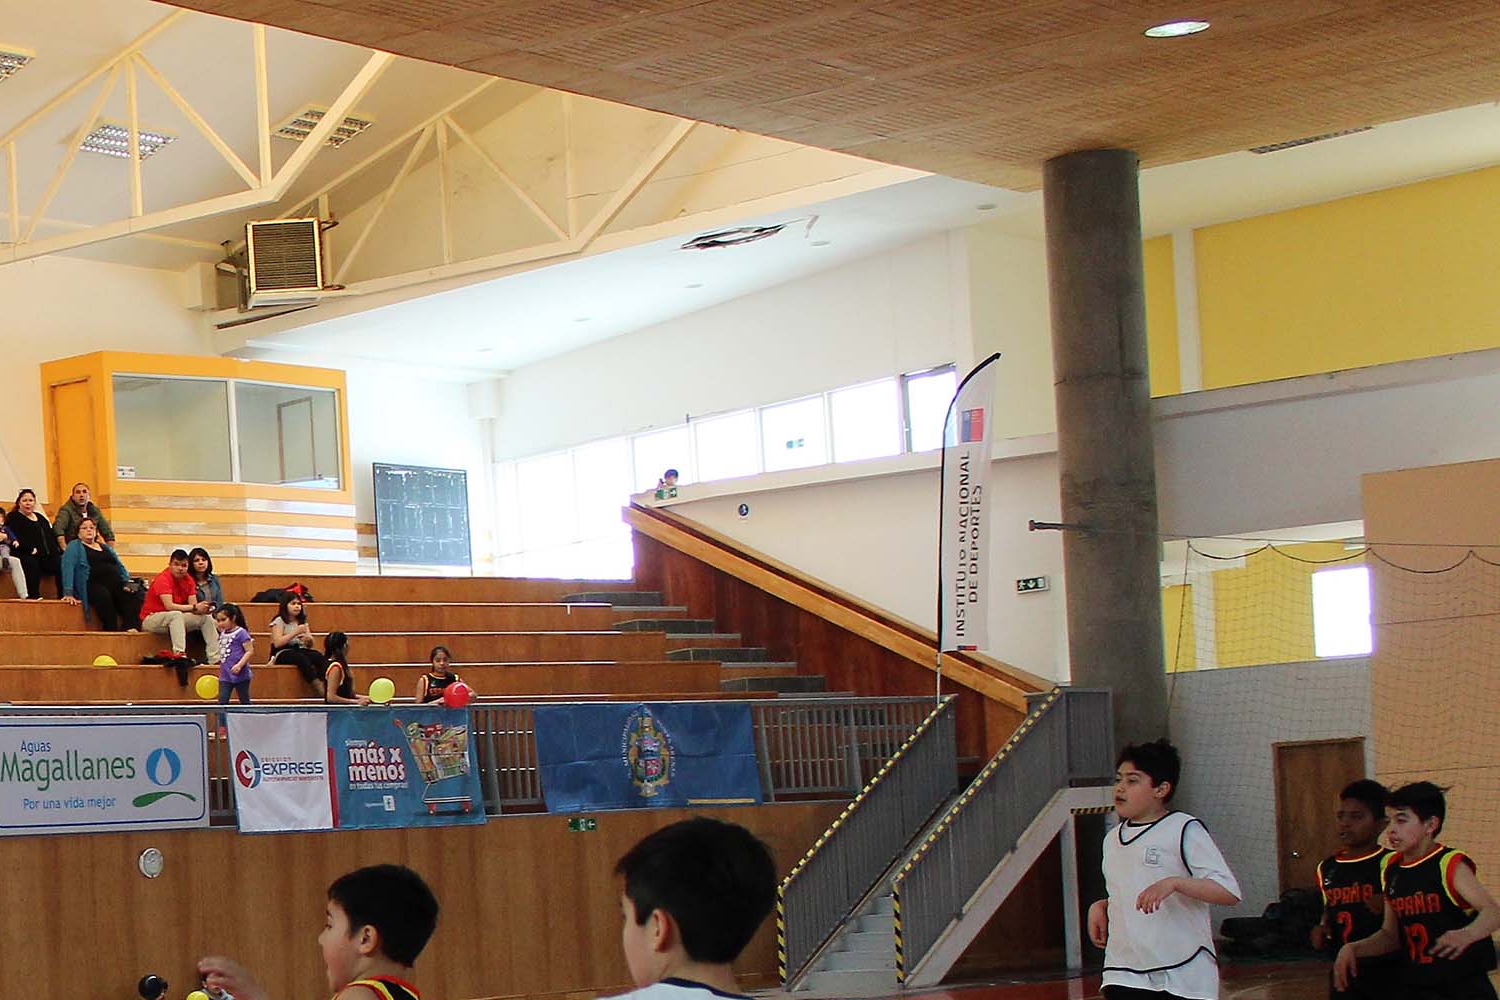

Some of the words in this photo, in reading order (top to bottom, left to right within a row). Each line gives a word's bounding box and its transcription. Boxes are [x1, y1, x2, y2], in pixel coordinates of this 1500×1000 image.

[959, 450, 970, 544] NACIONAL
[970, 485, 981, 574] DEPORTES
[956, 549, 966, 636] INSTITUTO
[969, 581, 978, 602] DE
[20, 740, 51, 756] Aguas
[349, 742, 385, 763] más
[389, 748, 402, 763] x
[0, 750, 135, 791] Magallanes
[262, 762, 324, 775] EXPRESS
[348, 764, 405, 781] menos
[23, 798, 39, 809] Por
[42, 799, 60, 809] una
[64, 796, 84, 808] vida
[88, 796, 116, 810] mejor
[1404, 923, 1434, 964] 12
